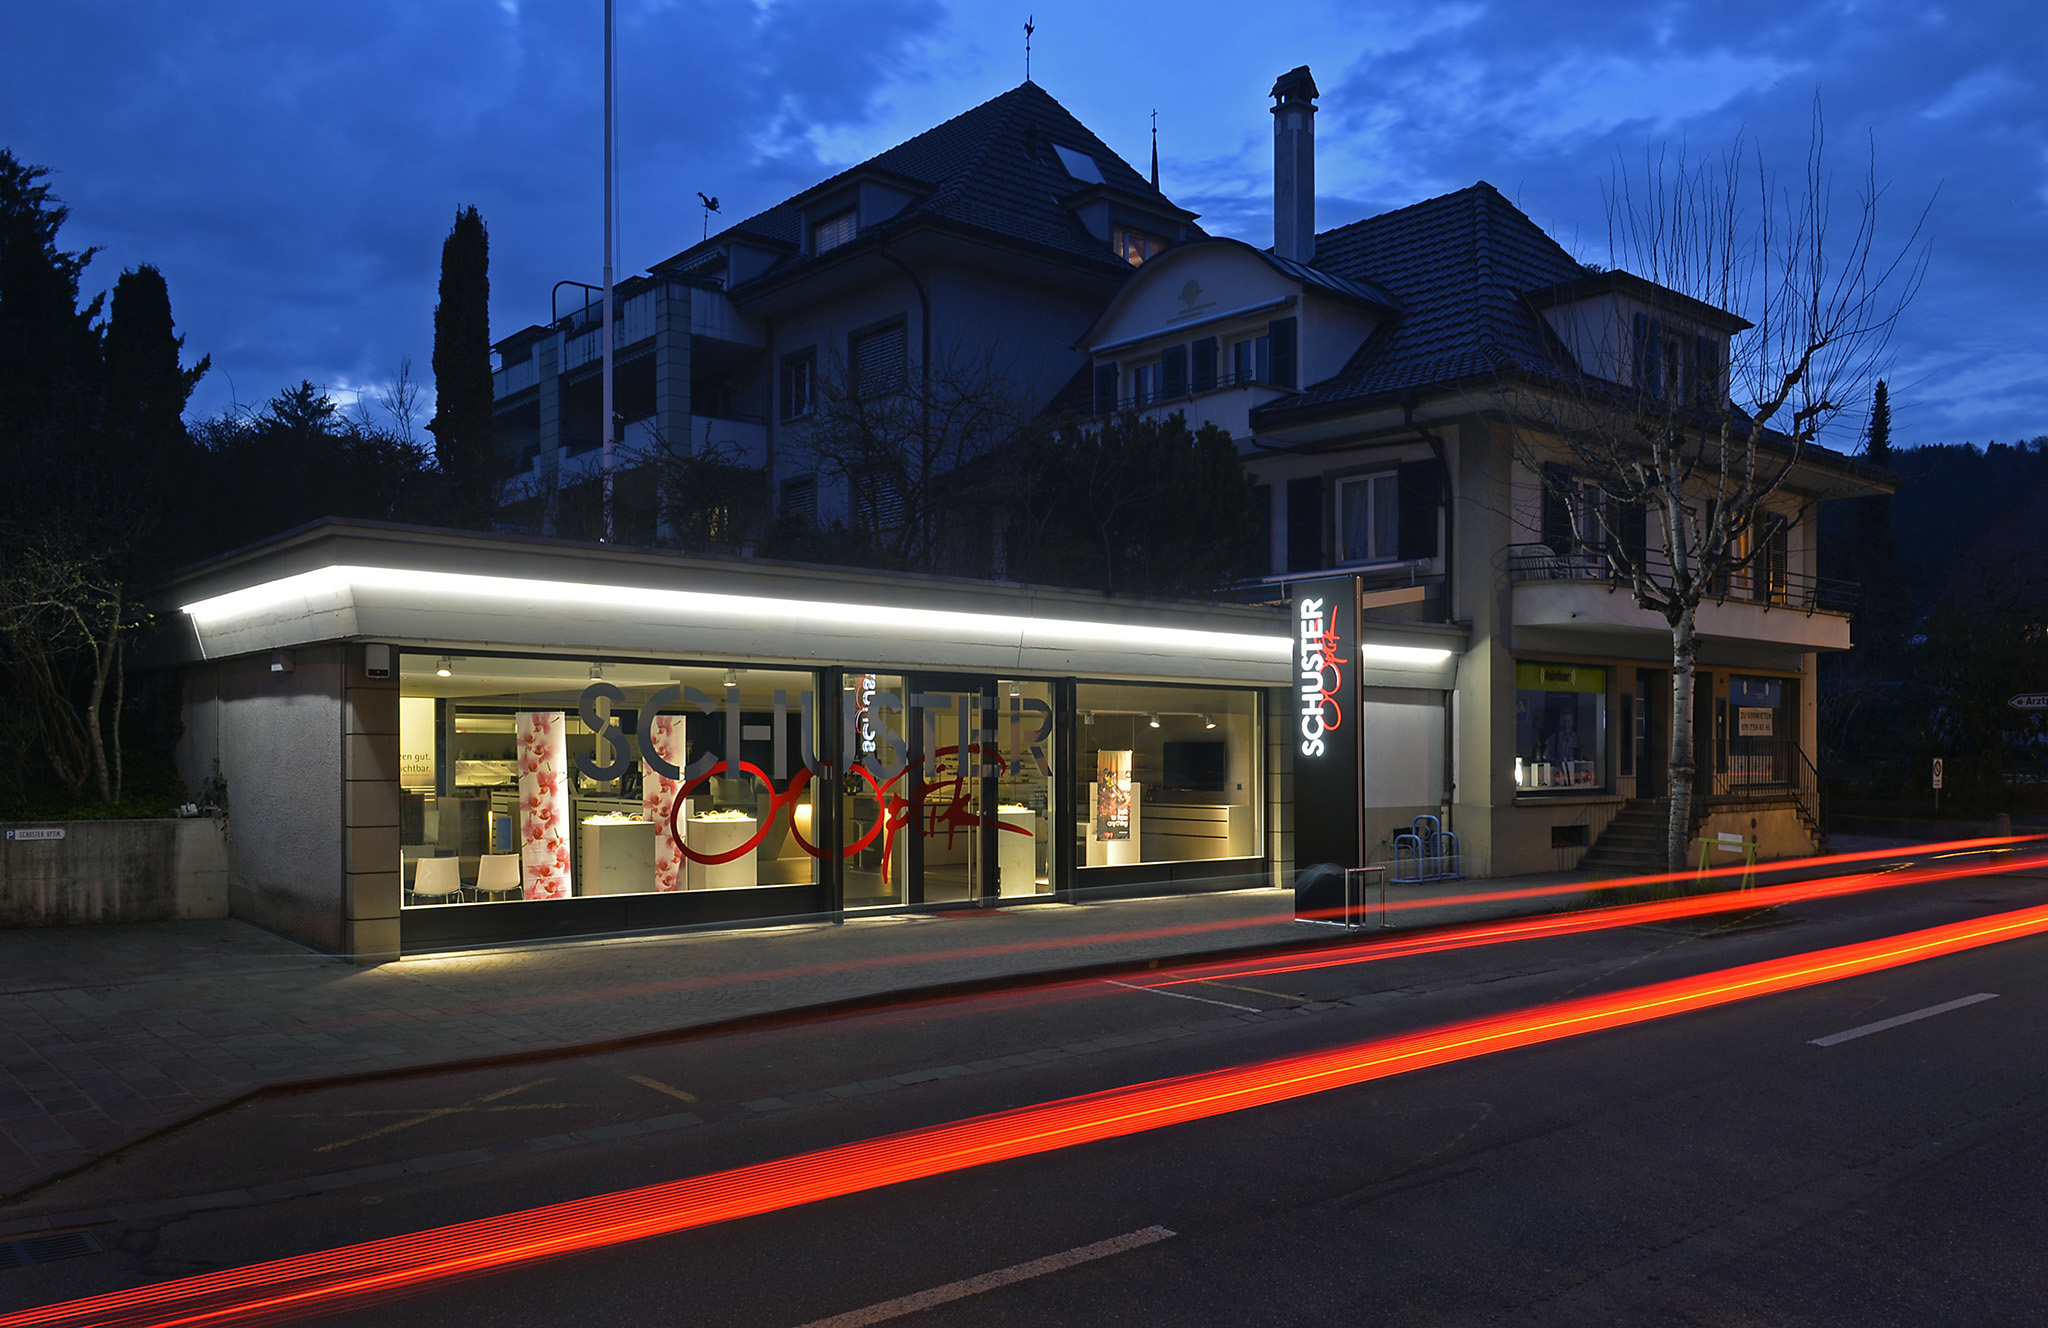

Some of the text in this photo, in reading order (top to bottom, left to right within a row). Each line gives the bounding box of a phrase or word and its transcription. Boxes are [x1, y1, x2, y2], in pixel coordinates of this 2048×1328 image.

[1300, 597, 1325, 757] SCHUSTER
[1747, 712, 1772, 720] VERMIETEN
[574, 682, 1053, 782] SCHUSTER
[414, 753, 431, 763] gut.
[46, 830, 61, 838] OPTIK
